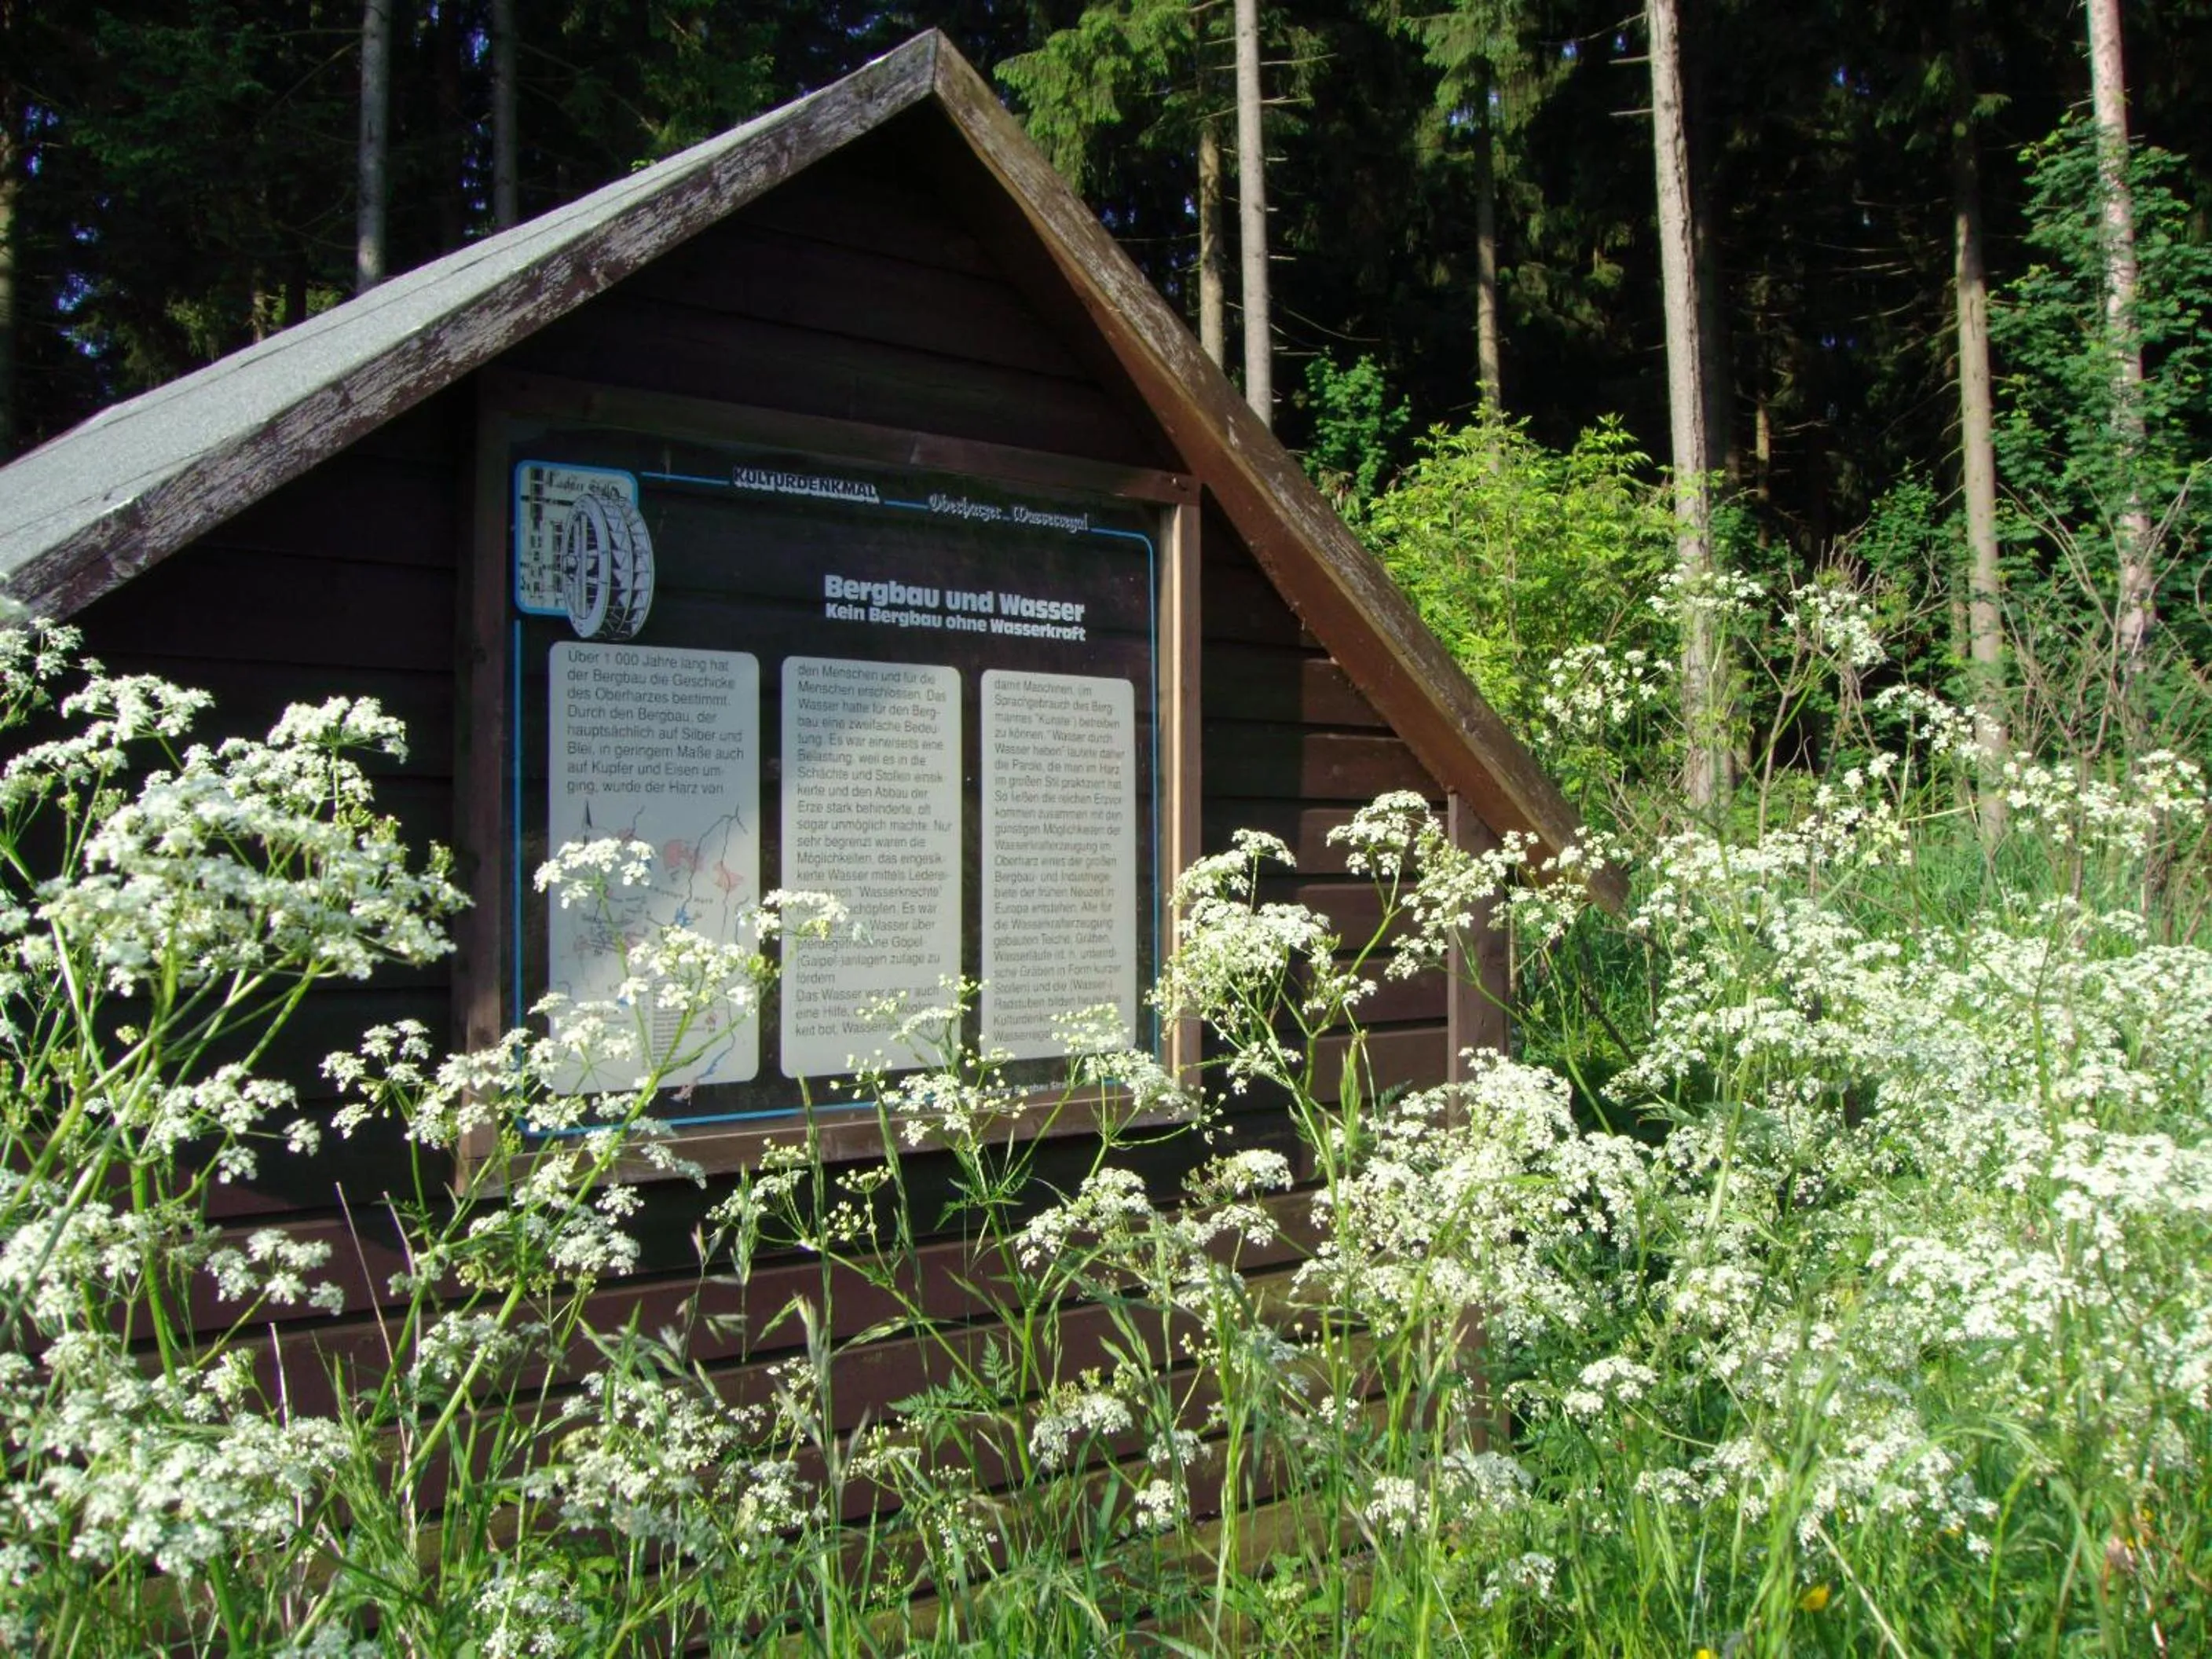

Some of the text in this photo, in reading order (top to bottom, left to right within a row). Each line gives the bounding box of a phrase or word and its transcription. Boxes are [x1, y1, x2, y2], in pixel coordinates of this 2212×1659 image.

[733, 466, 880, 504] KULTURDENKMAL
[824, 574, 1086, 622] Bergbau und Wasser
[826, 602, 1086, 643] Kein Bergbau ohne Wasserkraft
[643, 654, 676, 668] Jahre
[681, 656, 705, 673] lang
[709, 659, 729, 672] hat
[567, 668, 735, 689] der Bergbau die Geschicke
[798, 664, 819, 676] den
[822, 665, 878, 679] Menschen
[881, 670, 901, 683] und
[920, 672, 936, 684] die
[567, 687, 591, 700] des
[595, 687, 668, 703] Oberharzes
[798, 681, 854, 695] Menschen
[568, 705, 605, 719] Durch
[610, 706, 633, 720] den
[697, 711, 716, 723] der
[798, 698, 839, 711] Wasser
[843, 701, 870, 713] hatte
[873, 701, 886, 714] für
[889, 703, 909, 715] den
[797, 716, 819, 727] bau
[849, 717, 901, 731] zweifache
[567, 724, 742, 742] hauptsächlich auf Silber und
[830, 734, 843, 745] Es
[847, 736, 866, 746] war
[600, 742, 610, 756] in
[615, 743, 673, 760] geringem
[678, 746, 711, 760] Maße
[715, 748, 744, 760] auch
[859, 753, 880, 764] weil
[883, 755, 895, 764] es
[898, 754, 907, 765] in
[910, 755, 926, 766] die
[567, 761, 587, 774] auf
[591, 761, 634, 776] Kupfer
[638, 762, 661, 775] und
[665, 762, 699, 776] Eisen
[852, 769, 872, 781] und
[602, 779, 641, 793] wurde
[645, 780, 665, 793] der
[669, 781, 697, 794] Harz
[829, 785, 848, 797] und
[851, 786, 872, 797] den
[875, 786, 908, 798] Abbau
[911, 787, 928, 799] der
[798, 801, 823, 813] Erze
[826, 802, 852, 813] stark
[797, 819, 829, 835] sogar
[831, 818, 885, 833] unmöglich
[797, 835, 926, 849] sehr begrenzt waren die
[878, 852, 897, 864] das
[828, 870, 869, 881] Wasser
[903, 902, 937, 914] Es war
[870, 920, 909, 932] Wasser
[796, 989, 819, 1002] Das
[822, 988, 862, 1000] Wasser
